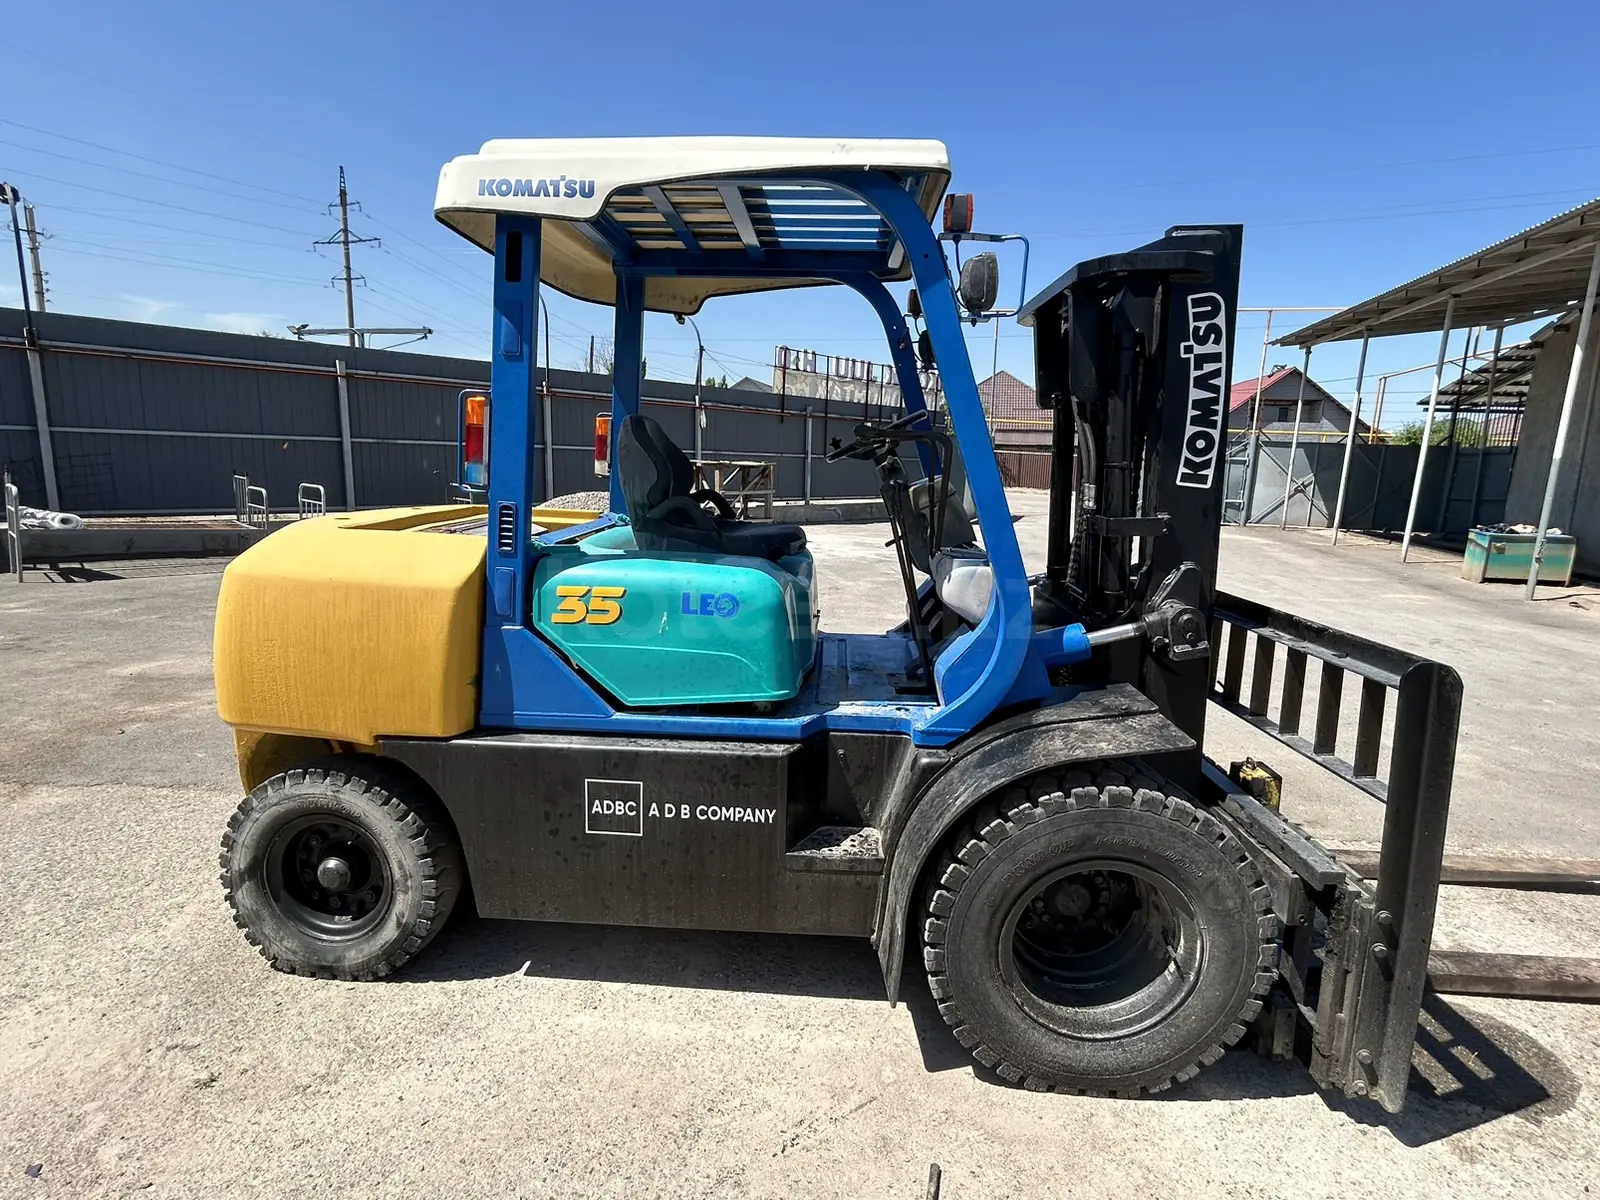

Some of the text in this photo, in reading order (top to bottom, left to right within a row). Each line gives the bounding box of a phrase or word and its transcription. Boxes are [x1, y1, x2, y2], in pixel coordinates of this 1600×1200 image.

[477, 174, 595, 199] KOMATSU
[1179, 295, 1223, 485] KOMATSU
[551, 585, 627, 625] 35
[681, 591, 740, 618] LEO
[591, 799, 637, 816] ADBC
[648, 802, 777, 824] A D B COMPANY
